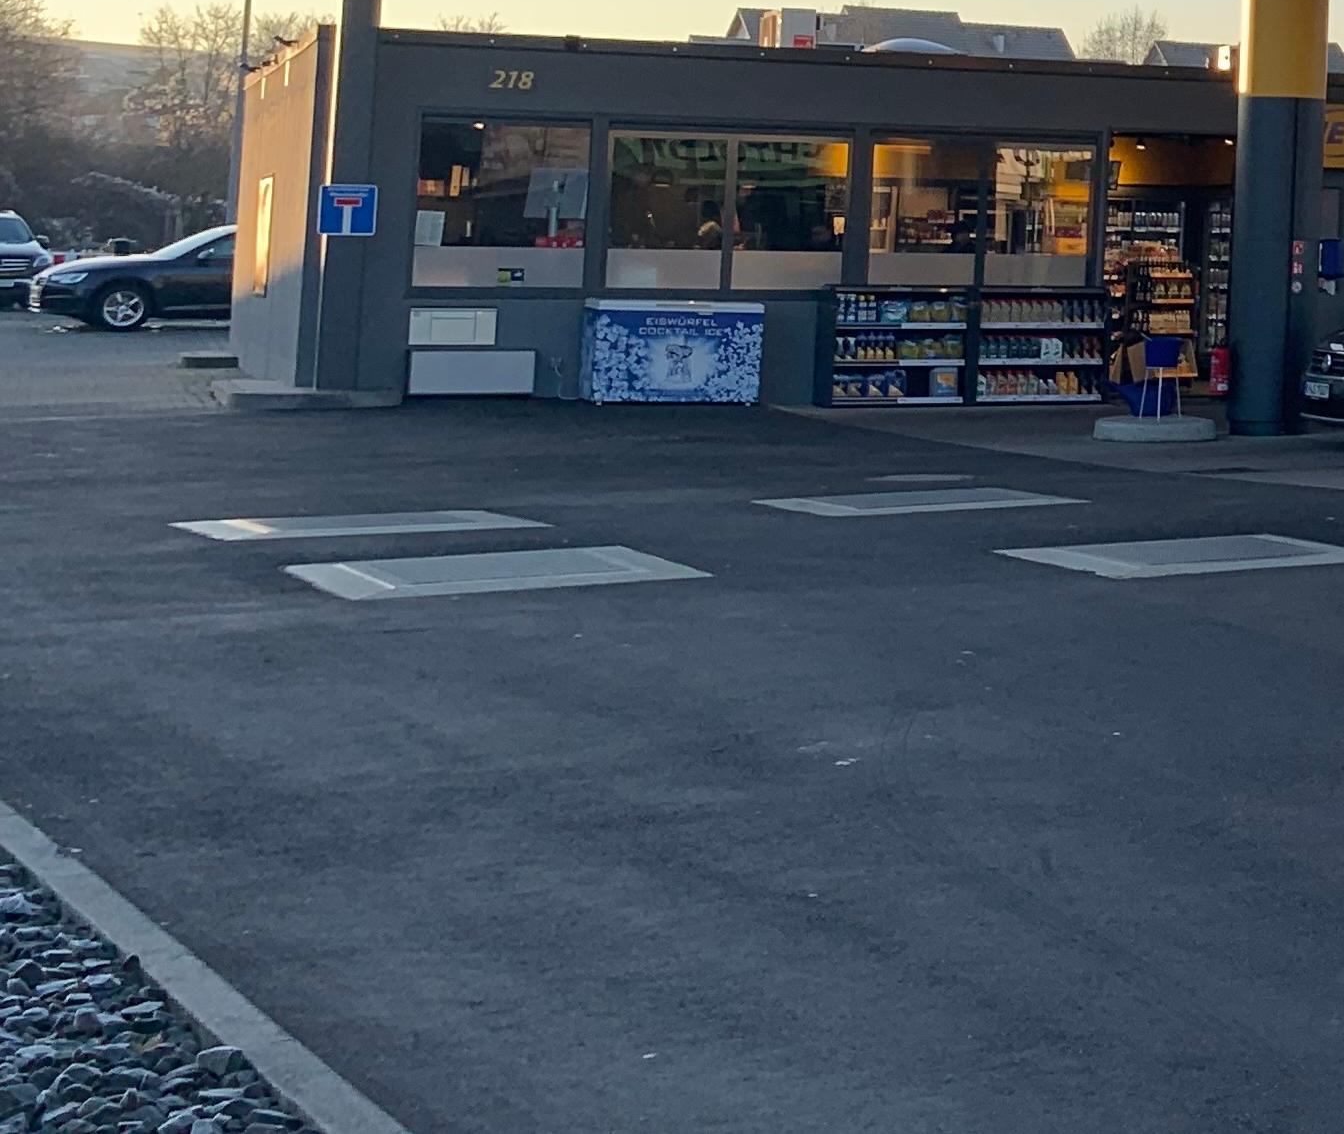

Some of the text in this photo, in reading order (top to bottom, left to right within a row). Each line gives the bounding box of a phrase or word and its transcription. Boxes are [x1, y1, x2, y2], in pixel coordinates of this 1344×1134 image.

[488, 70, 535, 90] 218
[645, 316, 719, 326] EISWÜRFEL
[638, 326, 699, 336] COCKTAIL
